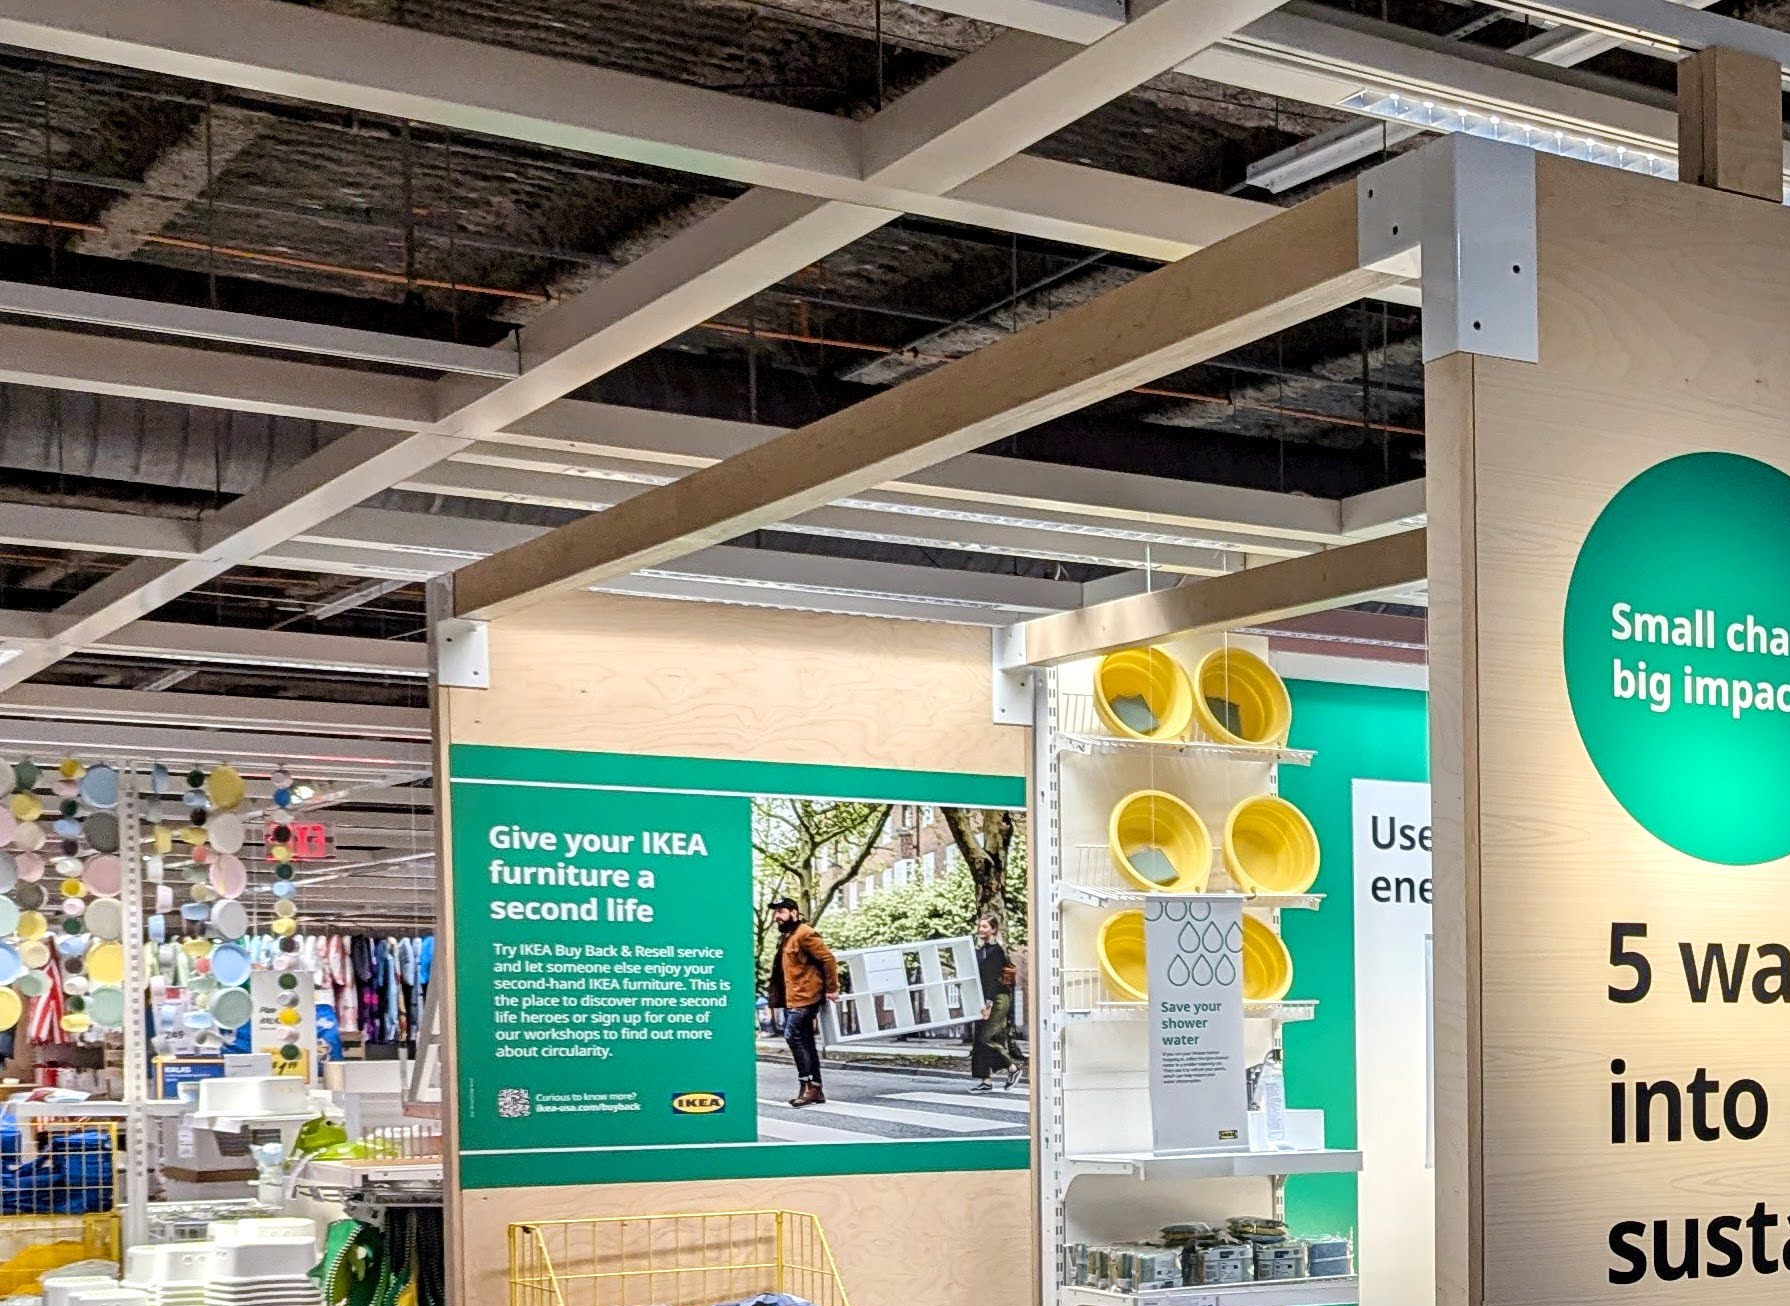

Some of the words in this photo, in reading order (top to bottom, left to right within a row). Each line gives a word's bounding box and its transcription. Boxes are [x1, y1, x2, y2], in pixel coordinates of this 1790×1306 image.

[1611, 602, 1714, 649] Small
[1613, 659, 1671, 712] big
[489, 825, 557, 850] Give
[564, 833, 634, 857] your
[642, 831, 708, 856] IKEA
[1372, 815, 1432, 852] Use
[489, 860, 629, 887] furniture
[638, 870, 654, 888] a
[490, 898, 598, 920] second
[607, 898, 653, 923] life
[493, 944, 517, 959] Try
[520, 945, 550, 956] IKEA
[556, 945, 582, 959] Buy
[585, 945, 618, 957] Back
[621, 946, 632, 957] &
[635, 946, 674, 958] Resell
[677, 947, 723, 958] service
[494, 961, 521, 973] and
[525, 961, 543, 973] let
[546, 963, 610, 974] someone
[614, 962, 641, 974] else
[645, 963, 681, 977] enjoy
[684, 965, 714, 977] your
[1608, 923, 1652, 1003] 5
[494, 978, 585, 990] second-hand
[589, 979, 620, 989] IKEA
[623, 978, 687, 990] furniture.
[690, 979, 717, 990] This
[720, 980, 730, 990] is
[495, 995, 518, 1007] the
[522, 995, 559, 1009] place
[562, 996, 577, 1007] to
[580, 995, 638, 1007] discover
[641, 997, 677, 1007] more
[680, 996, 727, 1007] second
[1162, 1002, 1190, 1012] Save
[1194, 1003, 1222, 1015] your
[495, 1011, 517, 1023] life
[521, 1012, 569, 1023] heroes
[573, 1014, 587, 1023] or
[591, 1012, 620, 1026] sign
[623, 1014, 641, 1026] up
[645, 1012, 664, 1023] for
[667, 1014, 692, 1023] one
[696, 1011, 711, 1023] of
[1162, 1018, 1208, 1029] shower
[495, 1031, 521, 1040] our
[524, 1028, 600, 1042] workshops
[604, 1029, 618, 1040] to
[621, 1028, 647, 1039] find
[650, 1030, 673, 1039] out
[677, 1030, 712, 1039] more
[1162, 1035, 1199, 1045] water
[496, 1046, 538, 1057] about
[541, 1045, 613, 1059] circularity.
[536, 1093, 570, 1101] Curious
[572, 1093, 582, 1101] to
[584, 1092, 607, 1100] know
[609, 1092, 637, 1100] more?
[678, 1099, 720, 1107] IKEA
[1610, 1059, 1768, 1143] into
